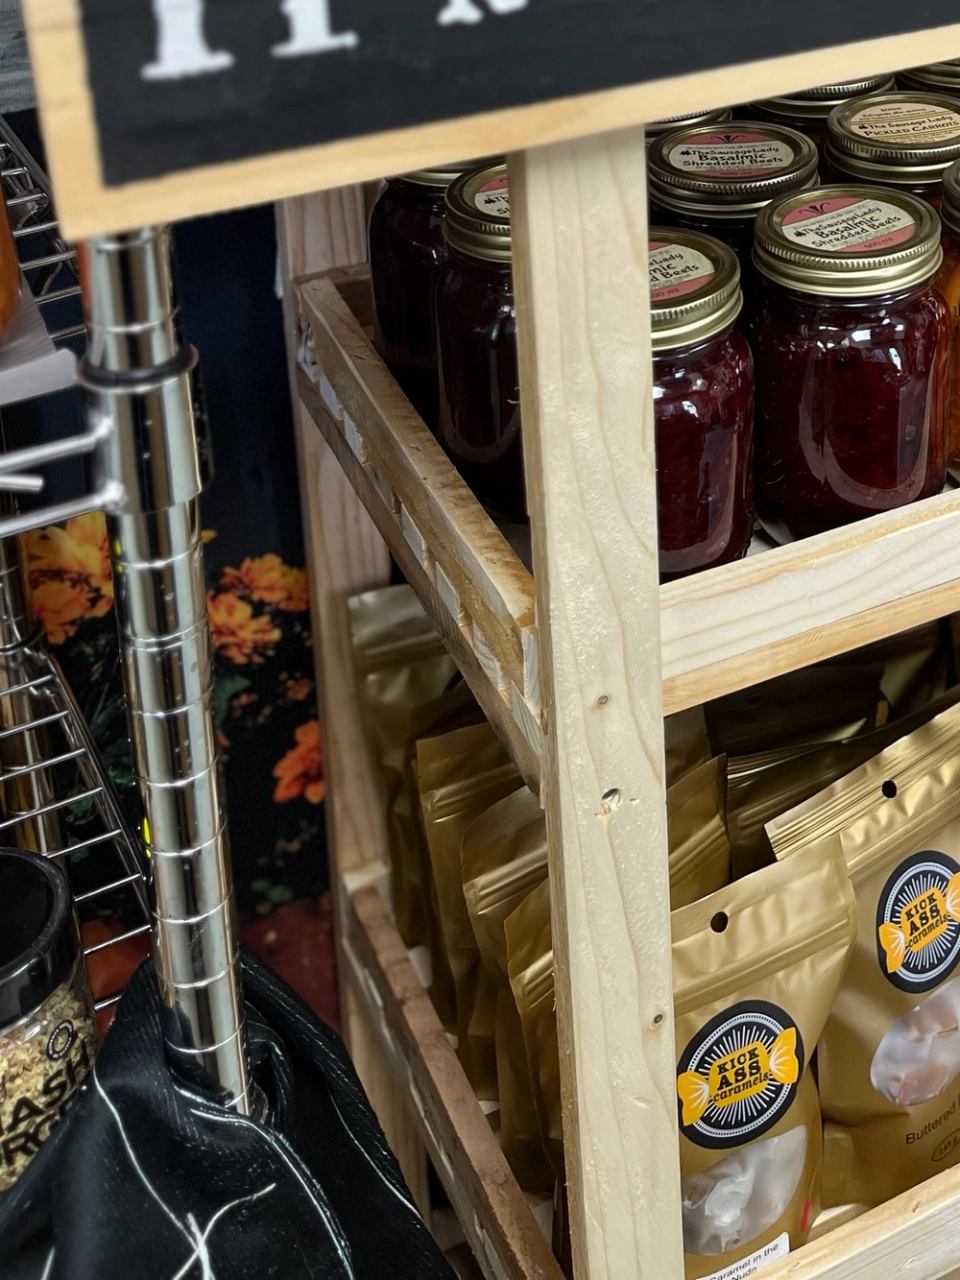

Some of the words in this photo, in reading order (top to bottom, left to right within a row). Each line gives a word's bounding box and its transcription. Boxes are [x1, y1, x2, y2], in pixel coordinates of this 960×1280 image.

[698, 153, 767, 162] Basalmic
[811, 227, 870, 247] Shredded
[867, 216, 902, 231] Beets
[815, 216, 880, 239] Basalmic
[660, 264, 700, 279] Beets
[905, 892, 938, 922] KICK
[909, 904, 941, 936] ASS
[907, 914, 949, 949] caramels
[716, 1047, 760, 1075] KICK
[717, 1059, 762, 1091] ASS
[0, 1036, 90, 1136] ASH
[712, 1072, 770, 1103] caramels
[905, 1103, 957, 1145] Buttered
[709, 1259, 752, 1280] Caramel
[751, 1253, 763, 1264] in
[763, 1243, 779, 1259] the
